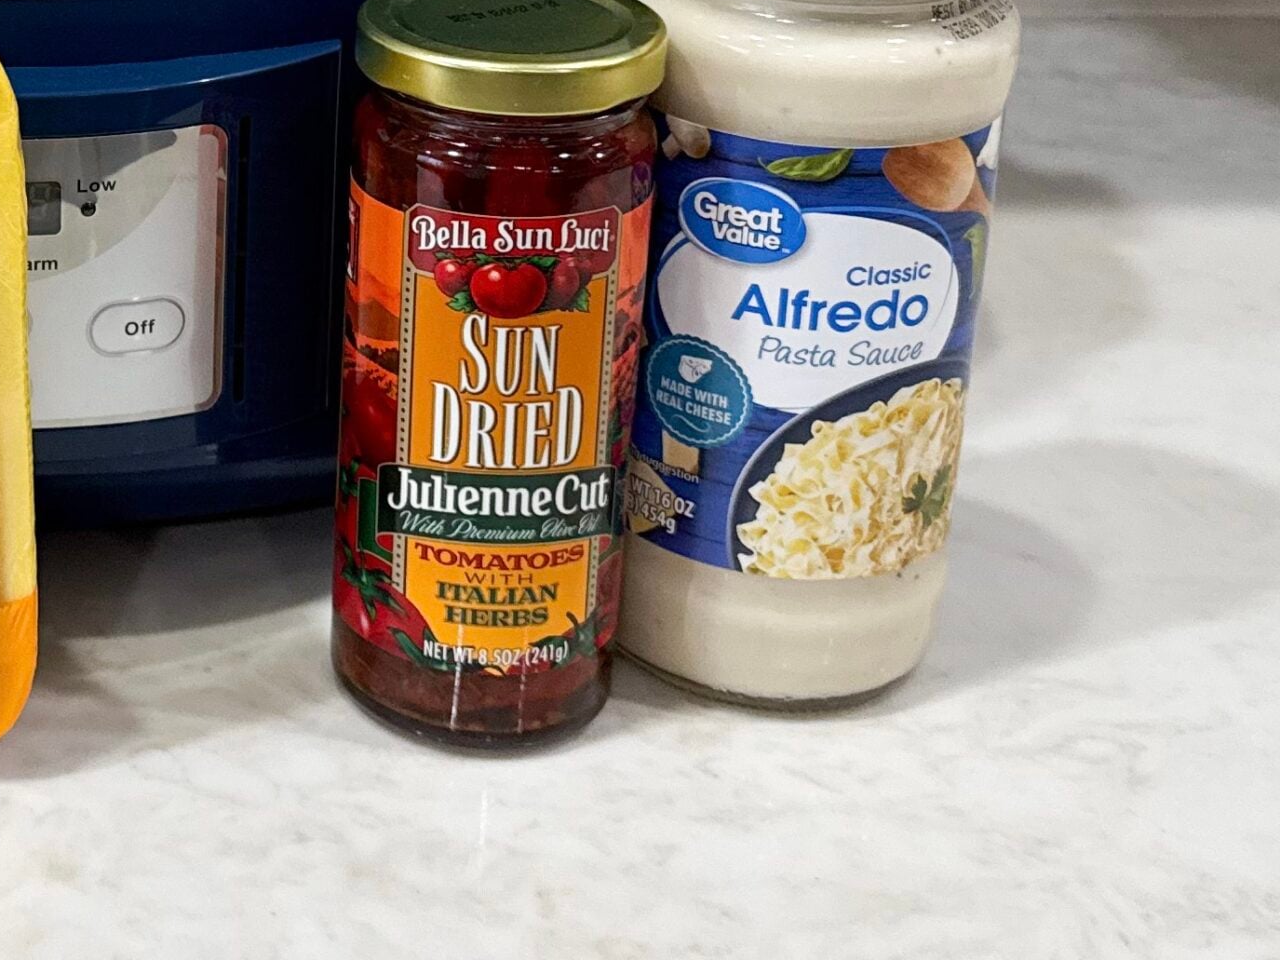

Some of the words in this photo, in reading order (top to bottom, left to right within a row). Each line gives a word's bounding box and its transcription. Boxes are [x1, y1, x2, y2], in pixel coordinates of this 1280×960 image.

[77, 179, 116, 193] Low
[693, 191, 784, 234] Great
[412, 215, 487, 252] Bella
[493, 219, 553, 252] Sun
[554, 219, 610, 252] Luci
[711, 219, 781, 251] Value
[27, 259, 58, 271] arm
[846, 261, 932, 287] Classic
[731, 283, 929, 333] Alfredo
[124, 319, 156, 336] Off
[459, 313, 561, 396] SUN
[757, 335, 837, 368] Pasta
[847, 340, 923, 368] Sauce
[661, 375, 693, 399] MADE
[694, 386, 729, 407] WITH
[656, 390, 683, 411] REAL
[685, 398, 732, 425] CHEESE
[430, 381, 582, 471] DRIED
[387, 467, 552, 516] Julienne
[555, 472, 609, 515] Cut
[630, 473, 652, 499] WT
[654, 489, 671, 508] 16
[674, 496, 696, 518] OZ
[400, 510, 444, 535] With
[447, 518, 535, 540] Premium
[540, 517, 577, 540] Olive
[577, 512, 601, 535] Oil
[641, 503, 677, 534] 454g
[414, 541, 585, 571] TOMATOES
[435, 580, 560, 605] ITALIAN
[465, 571, 533, 585] WITH
[443, 604, 549, 627] HERBS
[423, 640, 448, 661] NET
[452, 645, 474, 664] WT
[525, 641, 569, 665] (241g)
